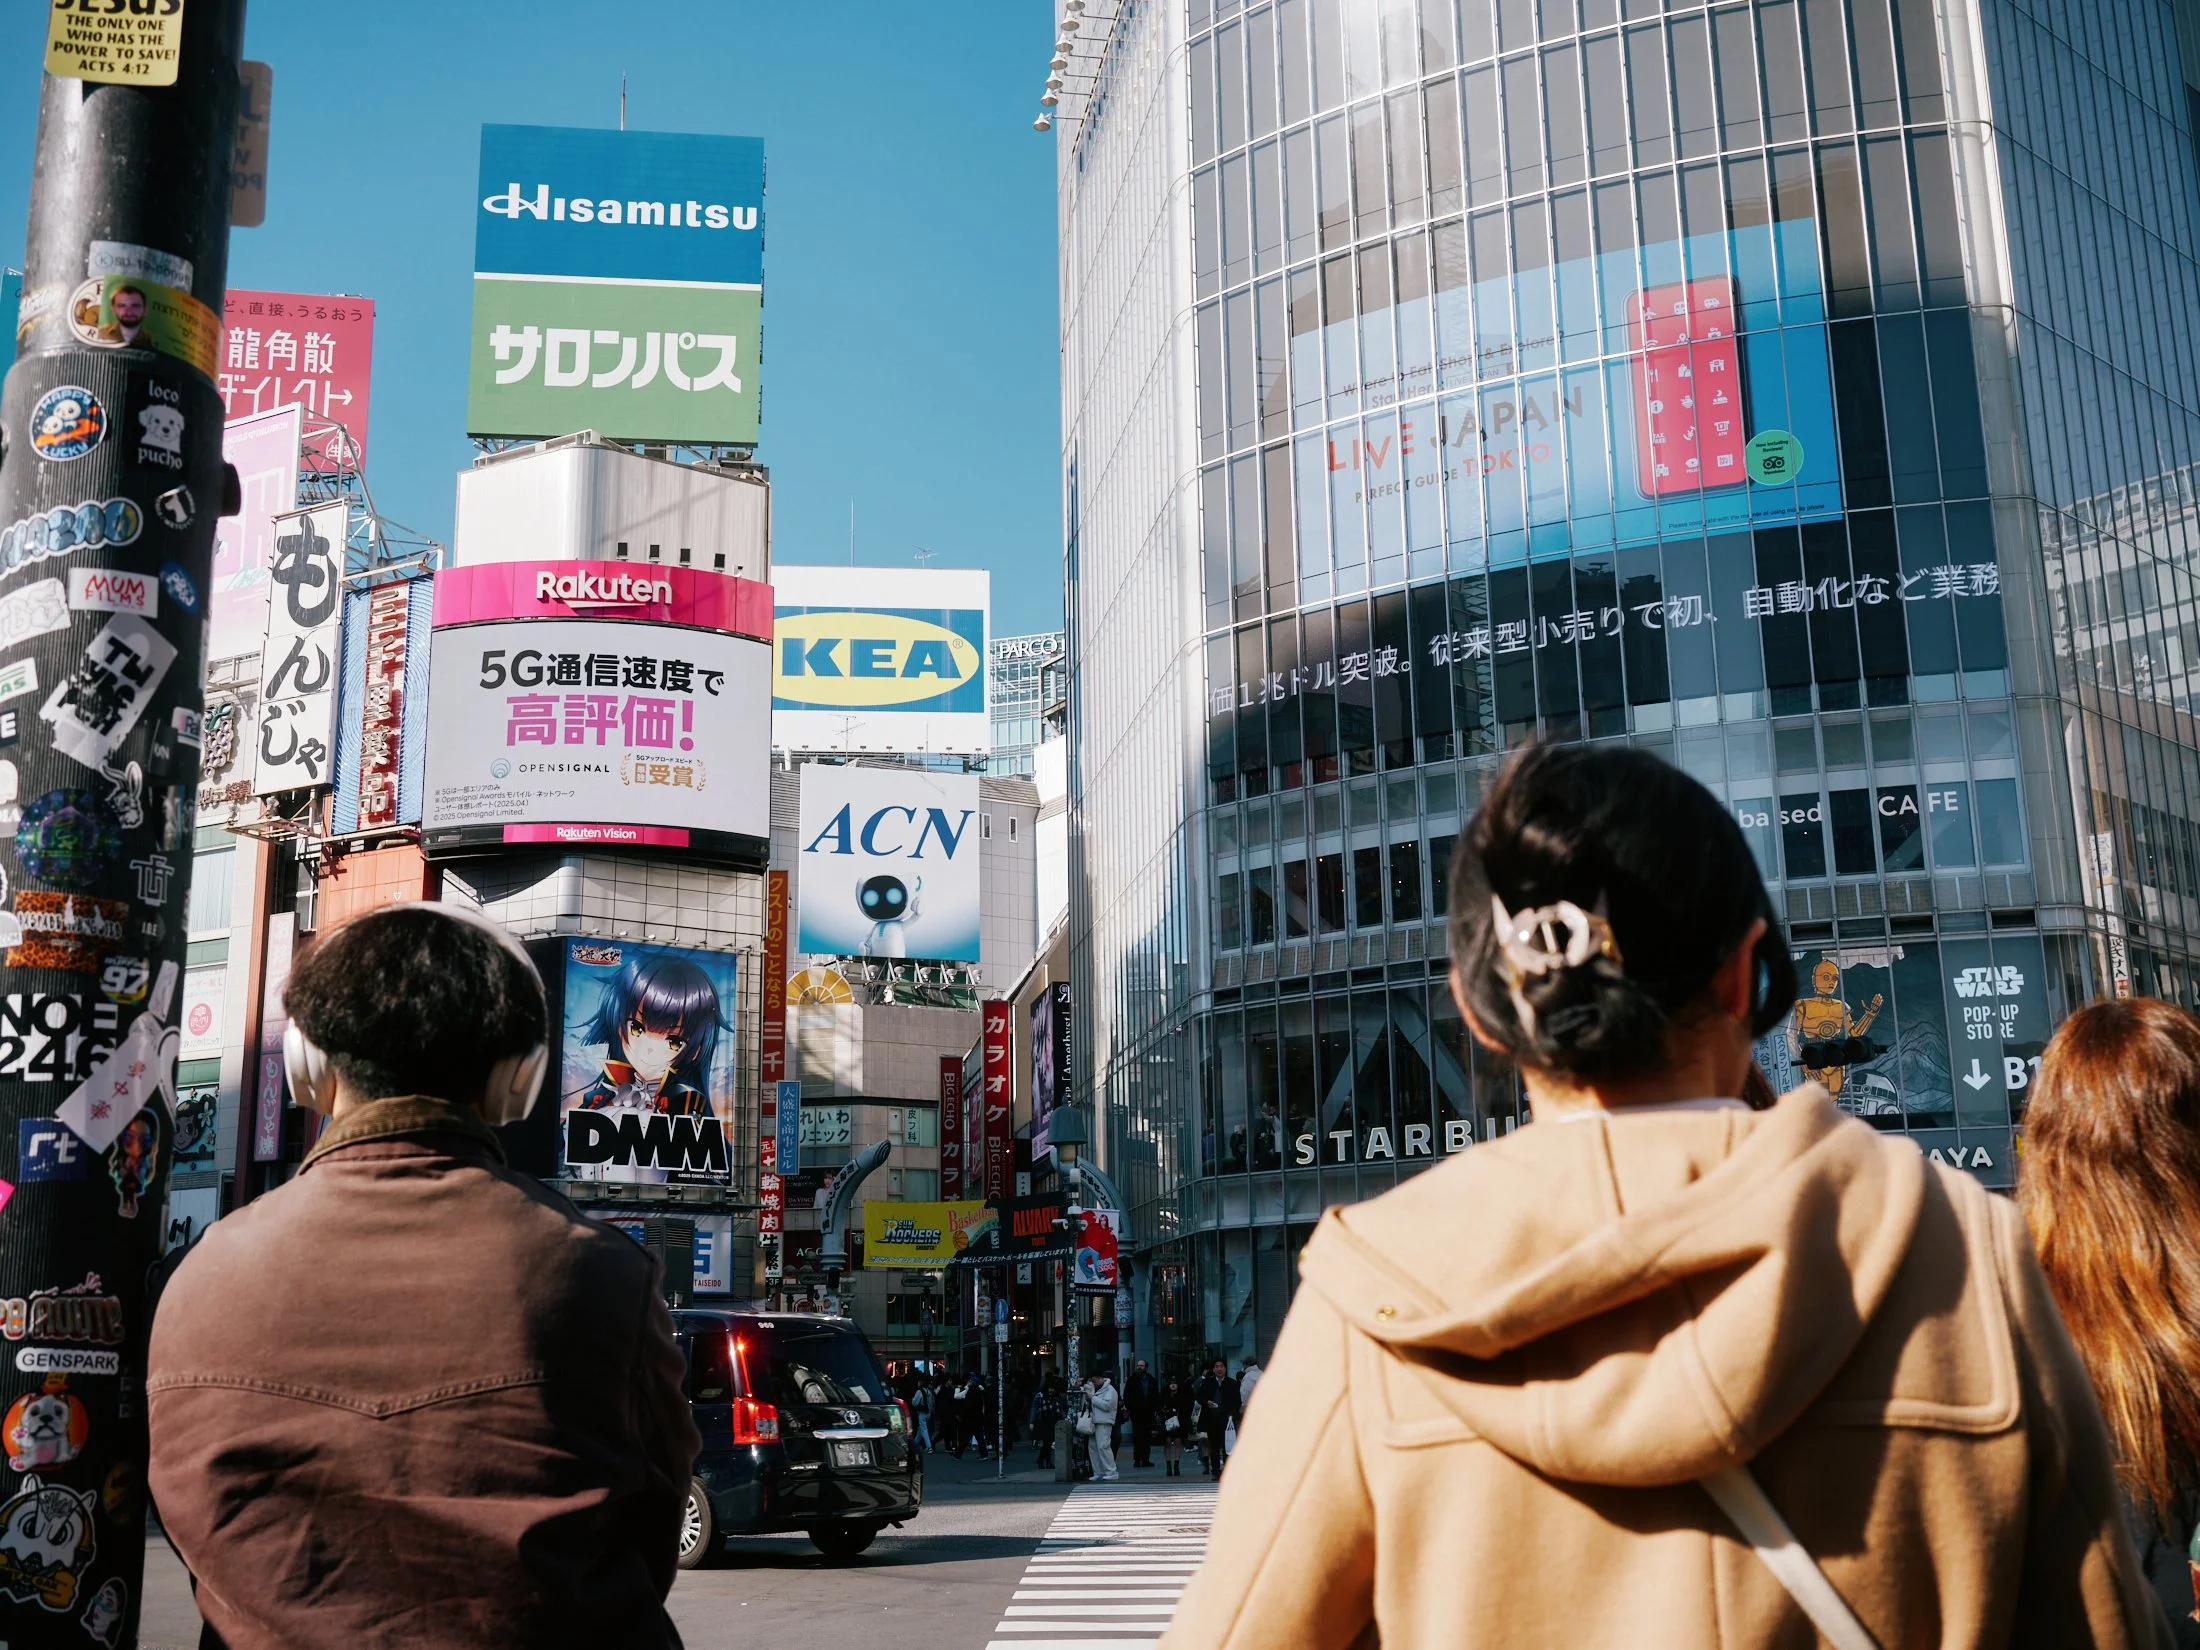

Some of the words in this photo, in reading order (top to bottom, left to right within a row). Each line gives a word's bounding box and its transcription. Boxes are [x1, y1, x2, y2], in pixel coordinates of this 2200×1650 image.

[66, 14, 94, 27] THE
[97, 17, 134, 30] ONLY
[137, 20, 166, 31] ONE
[67, 29, 103, 42] WHO
[107, 33, 134, 45] HAS
[140, 34, 166, 46] THE
[53, 41, 107, 58] POWER
[116, 48, 134, 60] TO
[139, 49, 176, 61] SAVE!
[79, 59, 115, 73] ACTS
[122, 63, 150, 75] 4:12
[482, 183, 758, 230] Hisamitsu
[228, 327, 337, 374] 龍角散
[490, 324, 742, 394] サロンパス
[148, 380, 180, 402] loco
[1343, 377, 1388, 397] Were
[41, 389, 92, 410] HAPPY
[1329, 421, 1415, 472] LIVE
[1430, 386, 1583, 448] JAPAN
[42, 441, 89, 458] LUCKY
[137, 446, 183, 469] pucho
[1355, 479, 1410, 503] PRFECT
[1669, 521, 1688, 529] Please
[1770, 509, 1786, 518] using
[1807, 504, 1825, 512] phone
[85, 573, 145, 597] MUM
[536, 569, 672, 605] Rakuten
[85, 590, 145, 609] FILMS
[261, 515, 338, 779] もんじゃ
[999, 637, 1058, 660] PARCO
[479, 649, 726, 697] 5G通信速度で
[357, 588, 400, 815] 三千里薬品
[506, 692, 695, 752] 高評価!
[518, 762, 610, 775] OPENSIGNAL
[649, 764, 694, 788] 受賞
[441, 793, 478, 805] Opensignal
[479, 791, 505, 800] Awards
[1738, 801, 1823, 829] based
[1878, 790, 1959, 817] CAFE
[440, 812, 456, 821] 2025
[457, 809, 495, 820] Opensignal
[496, 808, 525, 817] Limited.
[556, 826, 601, 840] Rakuten
[603, 828, 637, 839] Vision
[803, 802, 976, 861] ACN
[768, 877, 785, 1010] クスリのことなら
[100, 965, 150, 994] 97
[1953, 965, 2024, 984] STAR
[1954, 979, 2025, 998] WARS
[1963, 1004, 2019, 1023] POP-UP
[1966, 1022, 2015, 1040] STORE
[985, 1015, 1007, 1123] カラオケ
[907, 1109, 917, 1142] 皮フ科
[565, 1110, 729, 1171] DMM
[1295, 1115, 1530, 1165] STARBU
[1917, 1146, 1994, 1169] AYA
[885, 1218, 941, 1245] ROCKERS
[898, 1219, 914, 1229] SUN
[694, 1279, 722, 1288] TAISEIDO
[22, 1353, 116, 1370] GENSPARK
